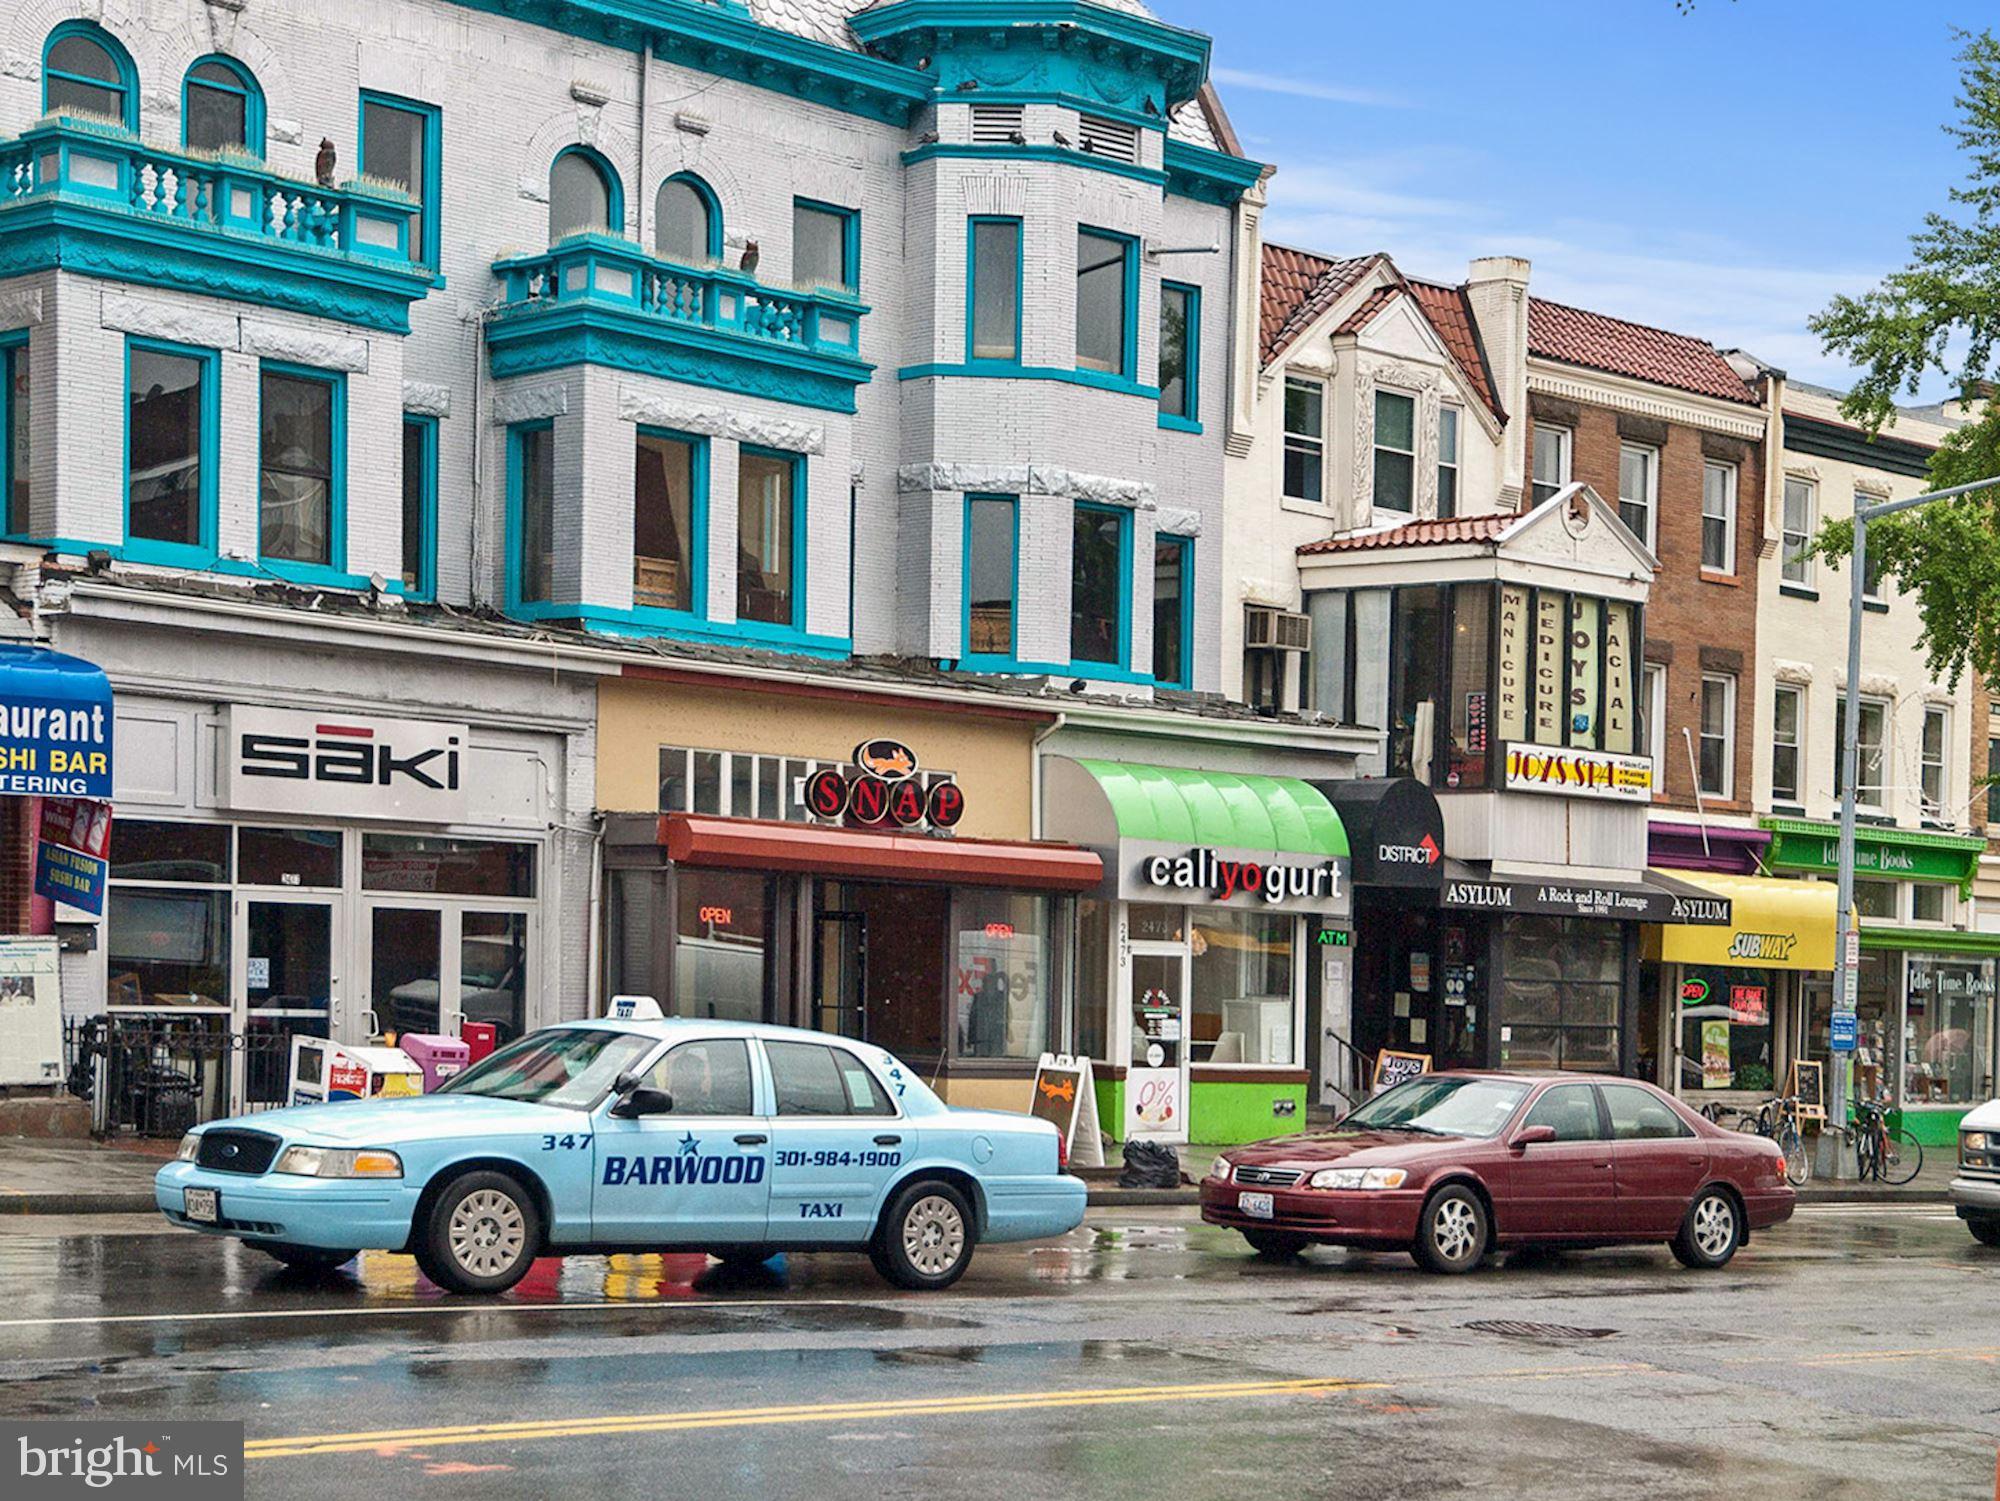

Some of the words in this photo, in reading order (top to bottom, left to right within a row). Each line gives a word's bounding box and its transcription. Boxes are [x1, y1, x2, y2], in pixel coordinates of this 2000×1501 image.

[1503, 594, 1521, 721] MANICURE
[1539, 602, 1556, 729] PEDICURE
[1570, 601, 1591, 706] JOYS
[1607, 613, 1624, 731] FACIAL
[50, 750, 107, 775] BAR
[1574, 756, 1615, 793] SPA
[817, 776, 960, 820] SNAP
[1823, 841, 1840, 864] Idl
[1880, 846, 1915, 870] Books
[1149, 848, 1342, 904] caliyogurt
[1446, 883, 1512, 907] ASYLUM
[1537, 886, 1548, 902] A
[1549, 886, 1574, 903] Rock
[1574, 889, 1593, 904] and
[1594, 890, 1614, 906] Roll
[1614, 891, 1649, 911] Lounge
[700, 907, 732, 924] OPEN
[1672, 900, 1729, 920] ASYLUM
[985, 923, 1013, 938] OPEN
[1317, 929, 1348, 946] ATM
[1728, 931, 1797, 960] SUBWAY
[1909, 969, 1932, 993] Idle
[1966, 972, 1996, 996] Books
[882, 1054, 907, 1097] 347
[1140, 1080, 1175, 1107] 0%
[541, 1134, 593, 1151] 347
[602, 1155, 766, 1186] BARWOOD
[775, 1150, 901, 1167] 301-984-1900
[799, 1203, 843, 1218] TAXI
